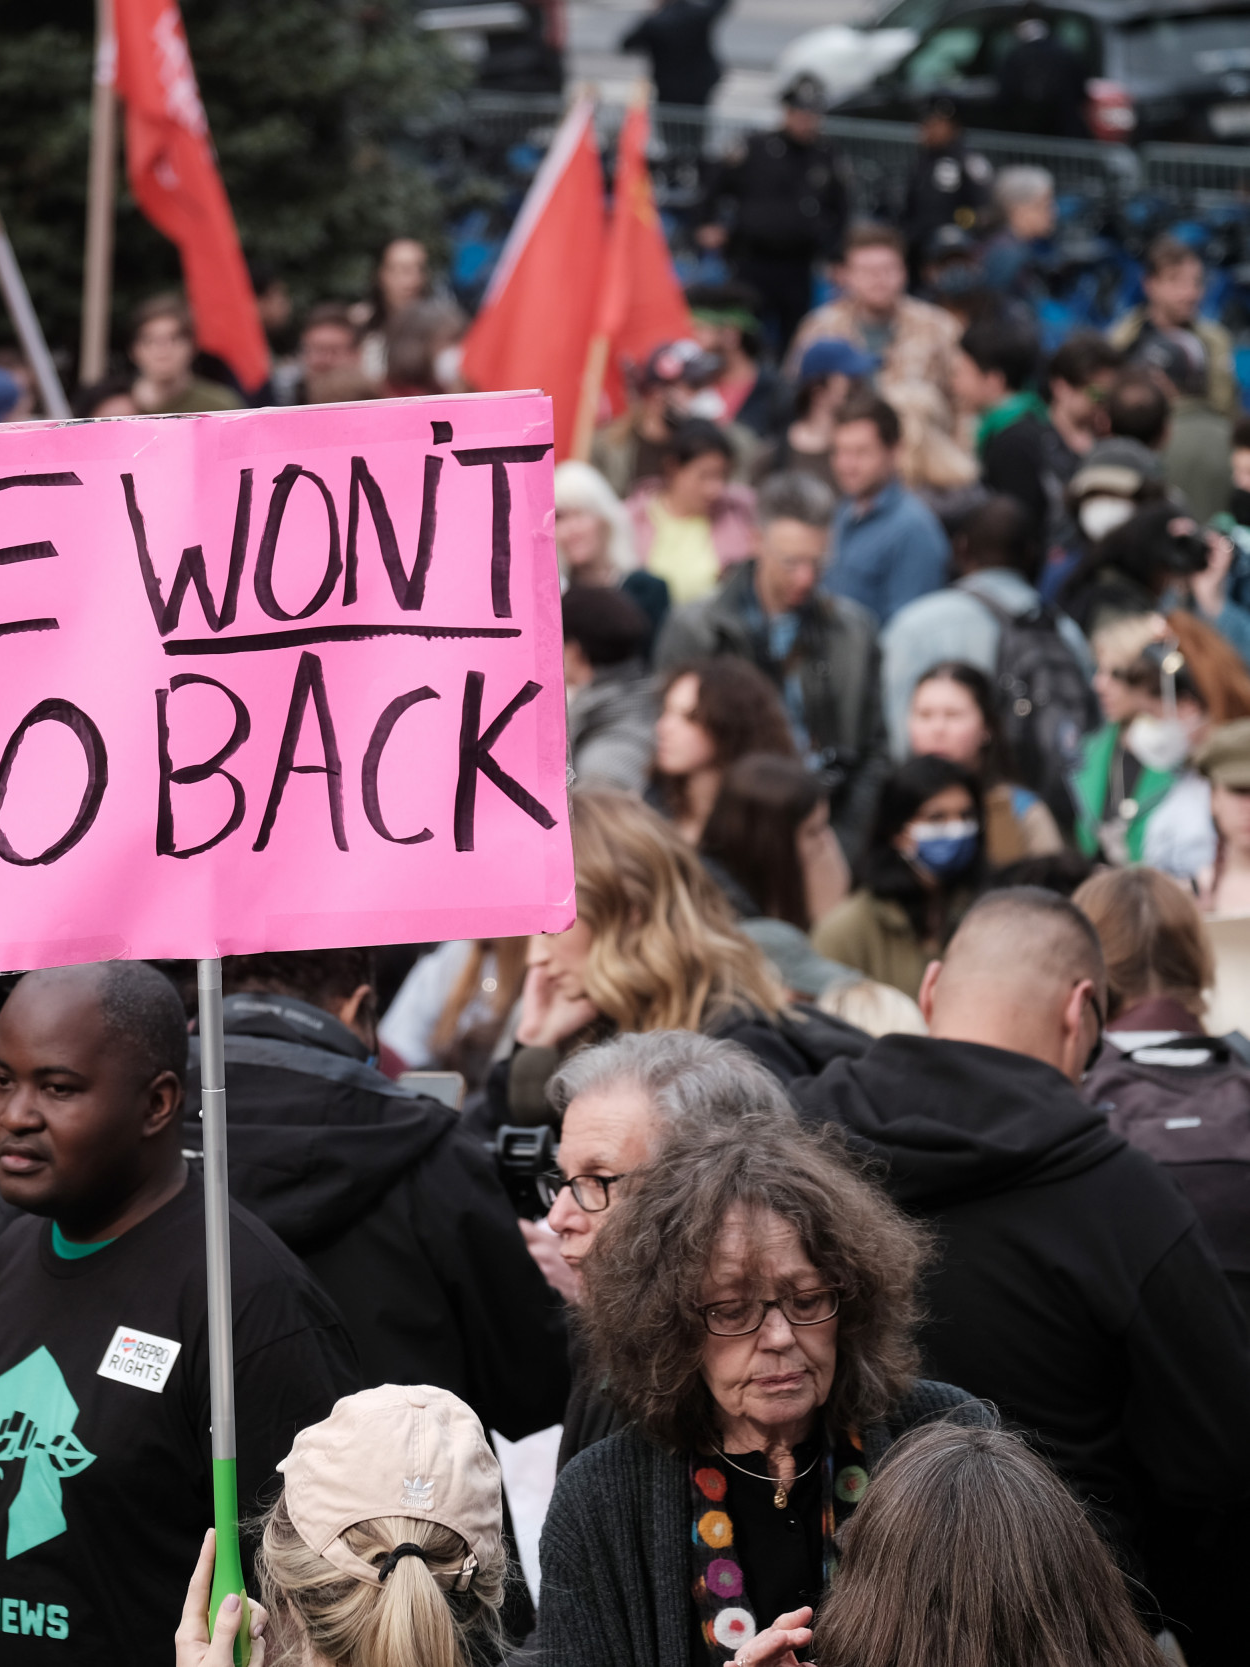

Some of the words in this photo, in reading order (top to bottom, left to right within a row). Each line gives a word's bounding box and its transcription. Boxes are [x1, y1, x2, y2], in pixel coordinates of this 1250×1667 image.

[154, 651, 558, 859] BACK
[133, 1341, 170, 1365] REPRO
[108, 1354, 163, 1382] RIGHTS
[401, 1496, 433, 1507] adidas
